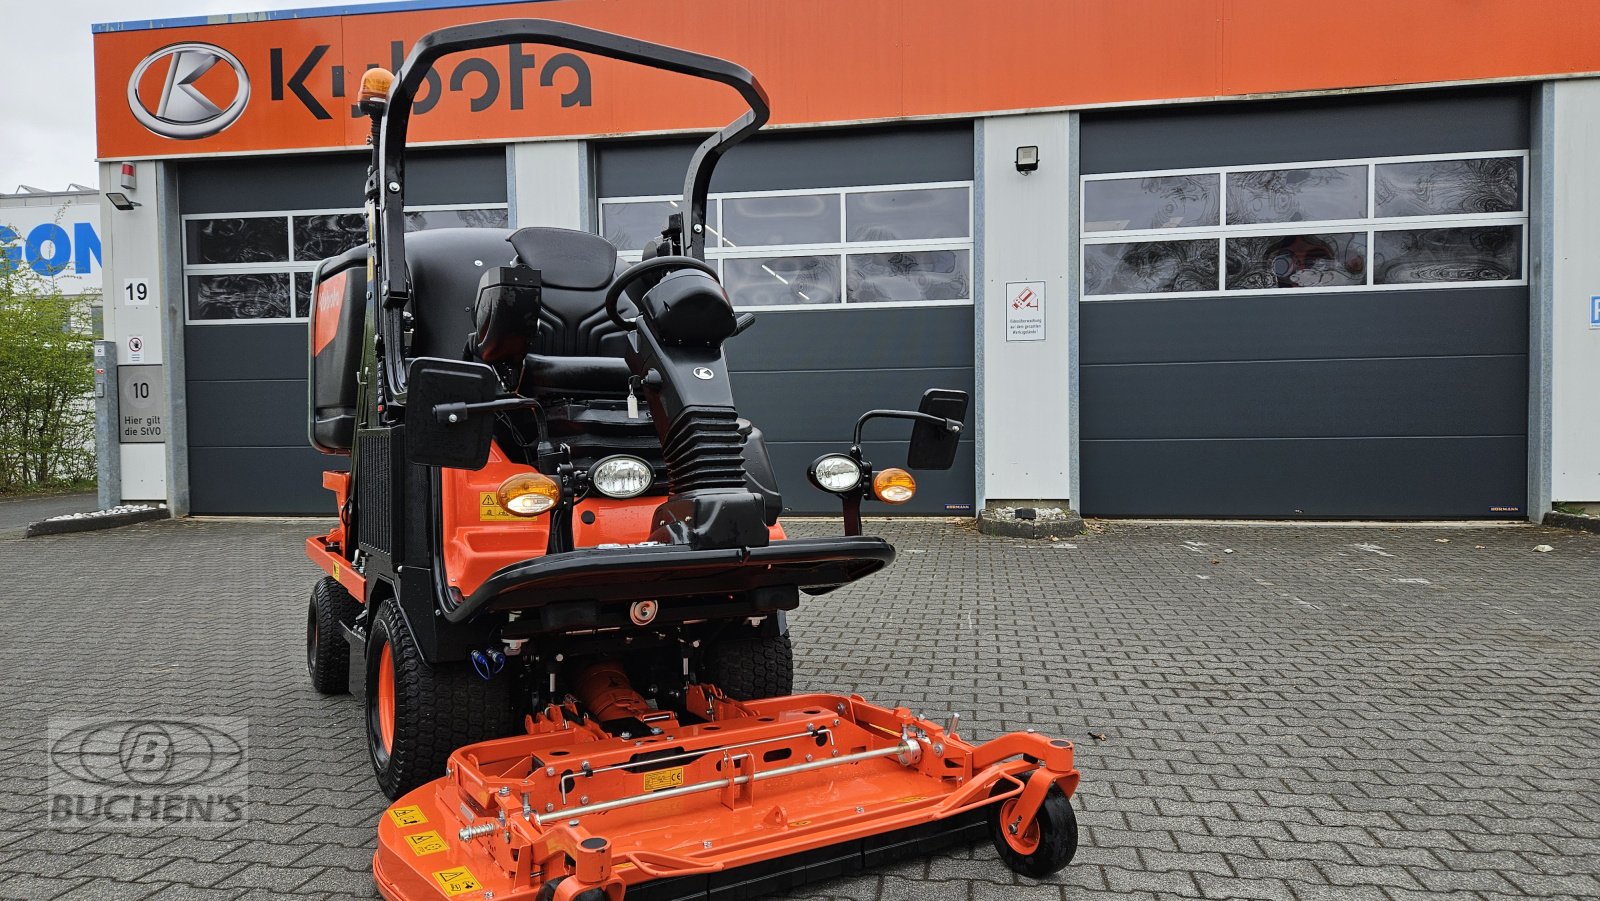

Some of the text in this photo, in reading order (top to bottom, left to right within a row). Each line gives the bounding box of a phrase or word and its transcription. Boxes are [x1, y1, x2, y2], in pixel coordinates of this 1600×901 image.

[125, 283, 147, 301] 19
[133, 382, 149, 399] 10
[124, 416, 161, 426] Hier gilt
[124, 427, 161, 436] die StVO
